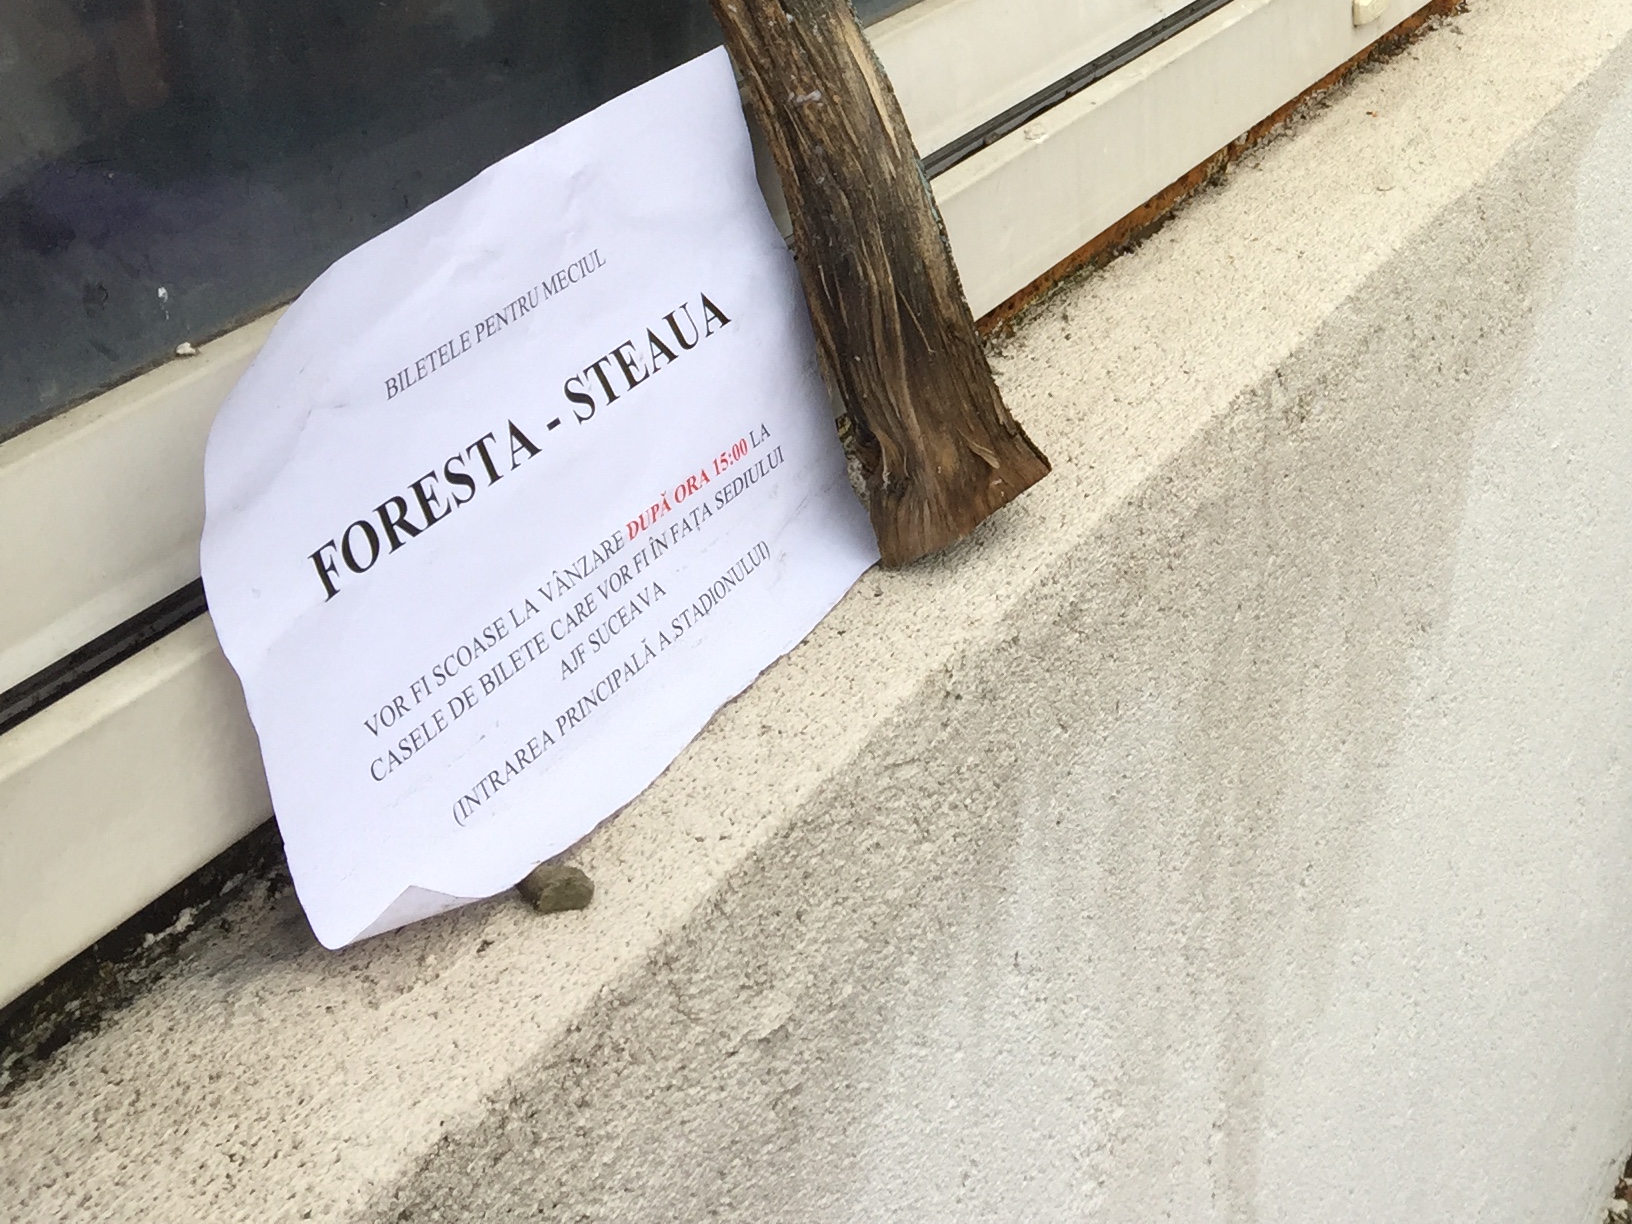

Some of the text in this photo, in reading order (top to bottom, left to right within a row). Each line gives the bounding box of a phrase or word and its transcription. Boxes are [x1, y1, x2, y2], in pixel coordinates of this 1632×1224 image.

[307, 419, 543, 603] FORESTA
[563, 291, 732, 425] STEAUA
[384, 248, 607, 401] BILETELE PENTRU MECIUL
[363, 422, 771, 738] VOR FI SCOASE LA VÂNZARE DUPĂ ORA 15:00 LA
[369, 708, 450, 782] CASELE
[446, 685, 480, 720] DE
[478, 631, 550, 697] BILETE
[550, 592, 598, 641] CARE
[597, 564, 634, 601] VOR
[632, 547, 651, 575] FI
[649, 534, 670, 561] ÎN
[714, 445, 785, 511] SEDIULUI
[452, 539, 772, 827] (INTRAREA PRINCIPALĂ A STADIONULUI)
[560, 580, 667, 681] AJF SUCEAVA
